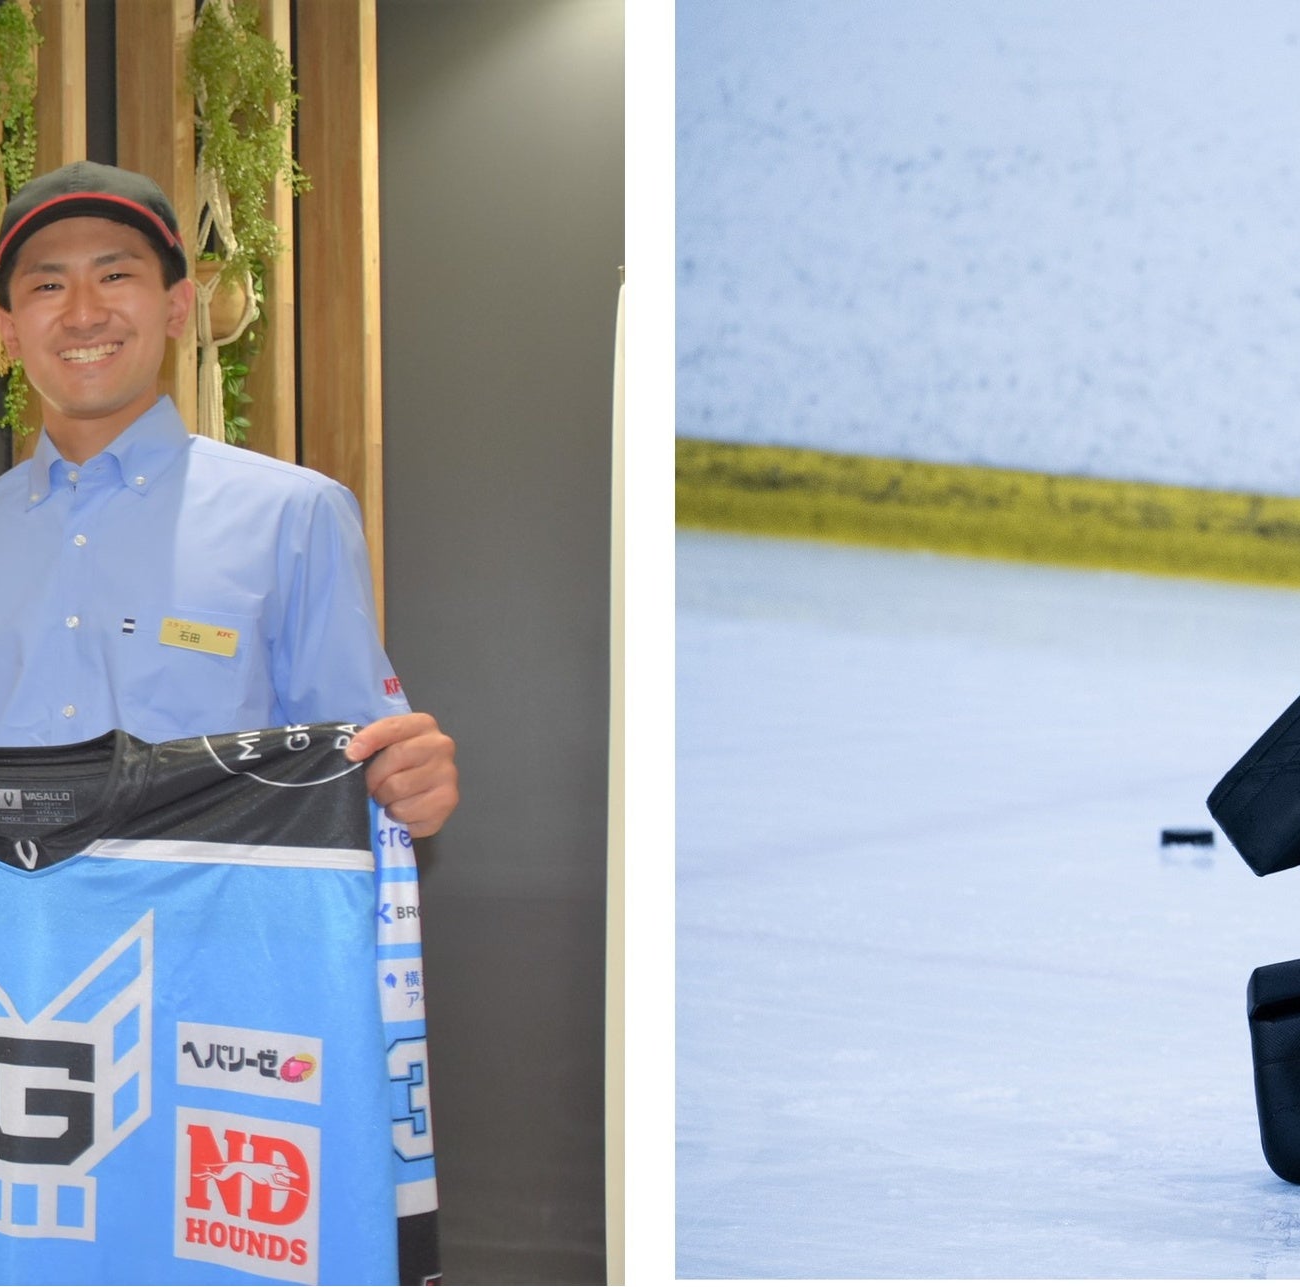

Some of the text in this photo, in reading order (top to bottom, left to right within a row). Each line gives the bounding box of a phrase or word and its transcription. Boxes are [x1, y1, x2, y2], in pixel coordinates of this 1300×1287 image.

[179, 630, 201, 643] 石田
[217, 630, 235, 639] KFC
[24, 792, 70, 801] VASALLO
[182, 1041, 280, 1080] ヘパリーゼ
[185, 1124, 310, 1226] ND
[186, 1217, 308, 1266] HOUNDS
